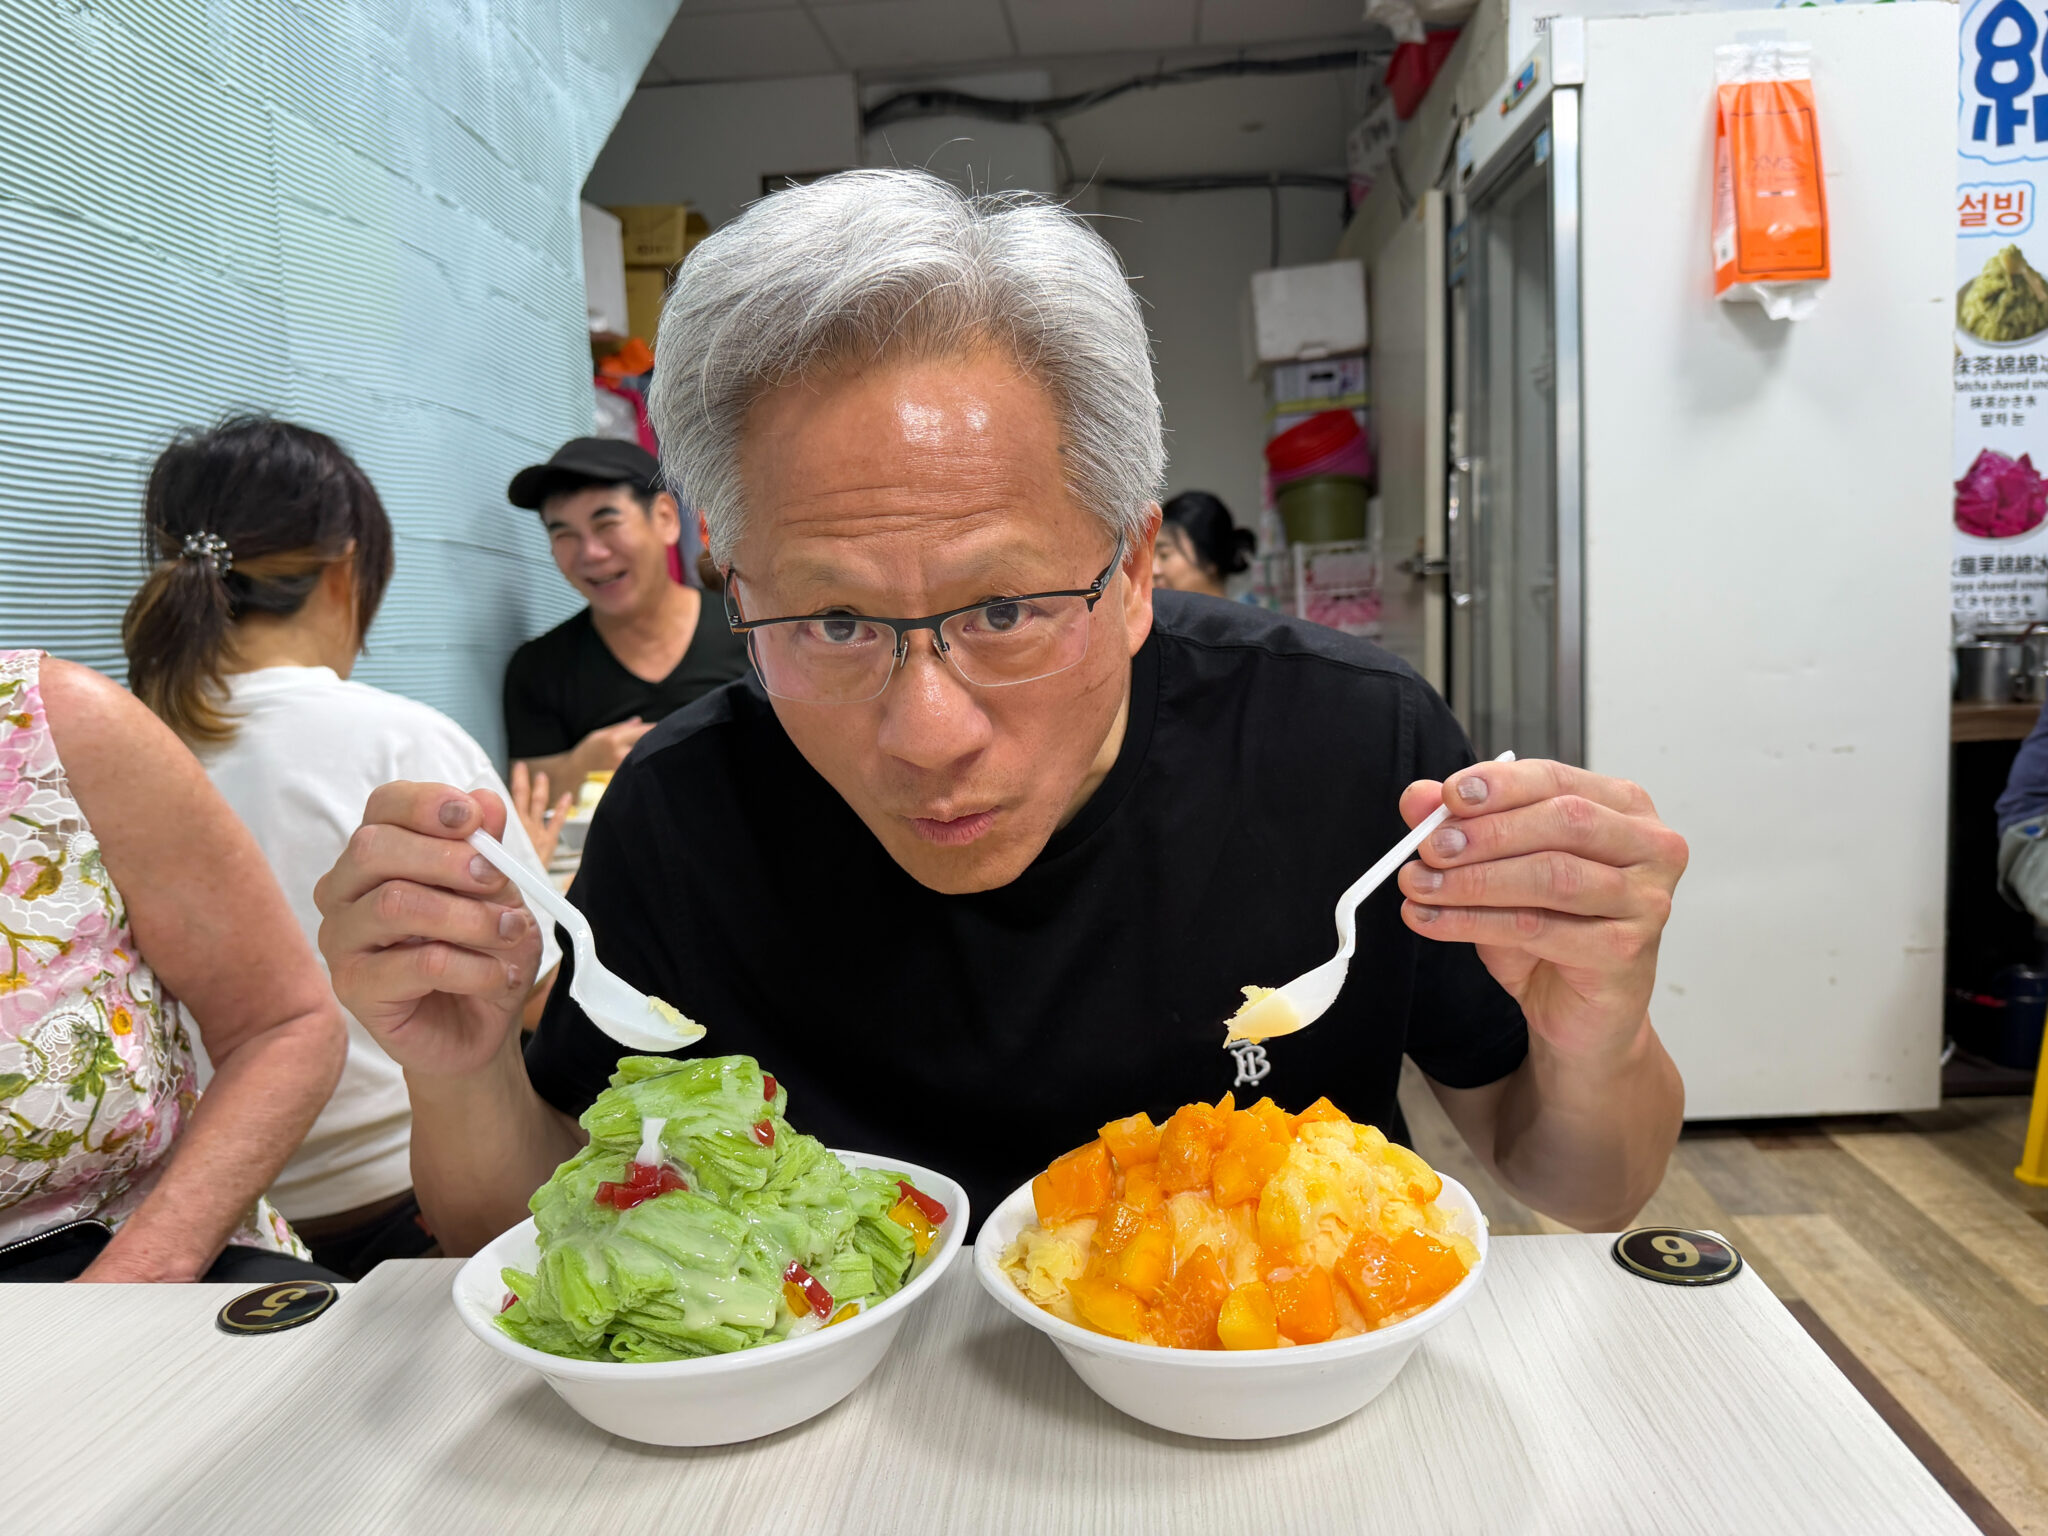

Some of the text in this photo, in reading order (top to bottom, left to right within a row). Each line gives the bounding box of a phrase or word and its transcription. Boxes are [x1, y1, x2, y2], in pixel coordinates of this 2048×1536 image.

[1957, 190, 2024, 227] 설빙
[1990, 379, 2030, 391] shaved
[1977, 580, 2017, 591] shaved
[244, 1288, 308, 1318] 5
